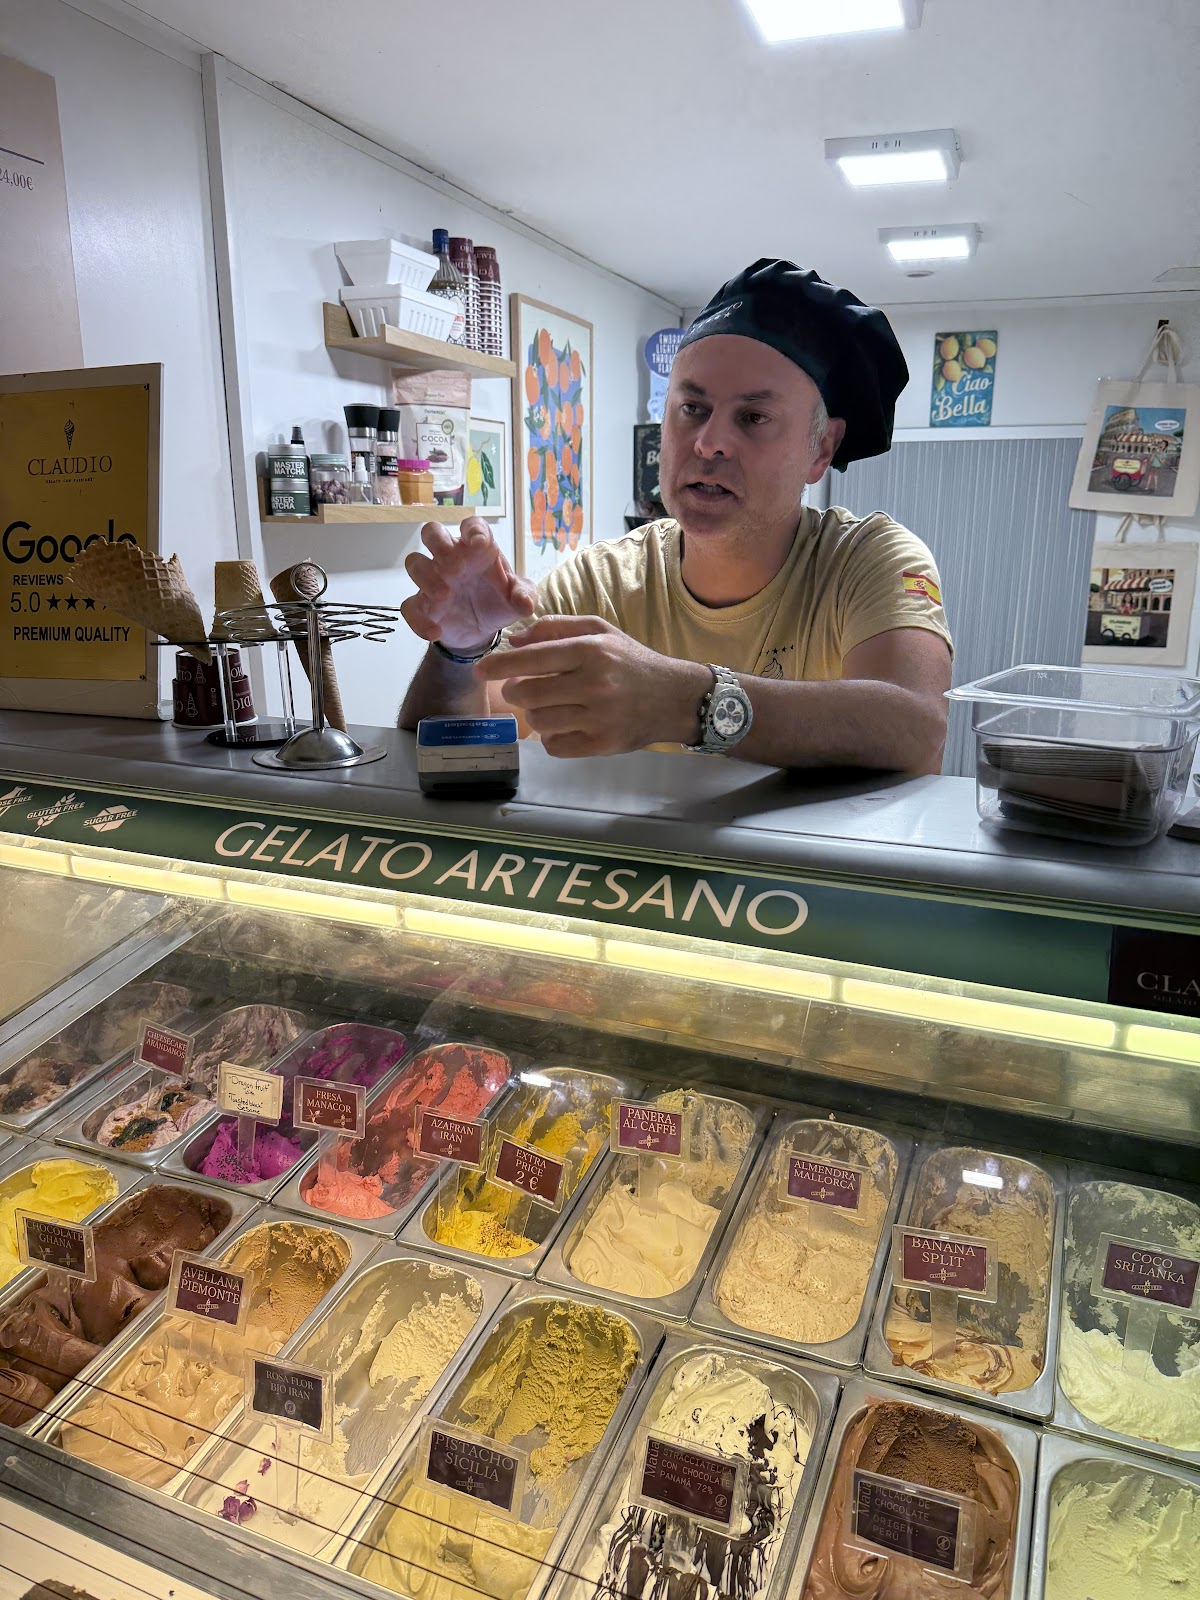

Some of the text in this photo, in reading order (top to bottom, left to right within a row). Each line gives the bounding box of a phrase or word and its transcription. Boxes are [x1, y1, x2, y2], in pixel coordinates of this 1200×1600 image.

[952, 370, 993, 396] Ciao
[931, 391, 988, 421] Bella
[421, 435, 449, 444] COCOA
[27, 455, 113, 476] CLAUDIO
[274, 460, 305, 469] MASTER
[274, 467, 306, 475] MATCHA
[13, 574, 64, 586] REVIEWS
[10, 591, 41, 613] 5.0
[13, 626, 131, 642] PREMIUM QUALITY
[12, 794, 34, 804] FREE
[26, 801, 86, 820] GLUTEN FREE
[83, 809, 139, 827] SUGAR FREE
[214, 821, 811, 936] GELATO ARTESANO
[146, 1038, 186, 1059] ARANDANOS
[147, 1030, 188, 1052] CHEESECAKE
[306, 1098, 352, 1114] MANACOR
[316, 1090, 343, 1103] FRESA
[622, 1118, 638, 1130] AL
[627, 1107, 673, 1125] PANERA
[430, 1118, 475, 1136] AZAFRAN
[440, 1131, 463, 1143] IRAN
[515, 1149, 547, 1169] EXTRA
[515, 1159, 544, 1178] PRICE
[515, 1170, 539, 1191] 2 €
[793, 1160, 857, 1182] ALMENDRA
[793, 1169, 855, 1191] MALLORCA
[26, 1220, 84, 1242] CHOCOLATE
[39, 1233, 73, 1250] GHANA
[911, 1237, 977, 1257] BANANA
[921, 1251, 965, 1268] SPLIT
[1131, 1251, 1173, 1269] COCO
[182, 1266, 241, 1292] AVELLANA
[1114, 1259, 1186, 1285] SRI LANKA
[180, 1278, 240, 1305] PIEMONTE
[266, 1370, 314, 1391] ROSA FLOR
[270, 1382, 311, 1401] BIO IRAN
[435, 1433, 515, 1471] PISTACHO
[444, 1451, 500, 1483] SICILIA
[661, 1459, 731, 1488] CON CHOCOLATE
[660, 1470, 714, 1495] PANAMÁ 72%
[874, 1498, 930, 1522] CHOCOLATE
[918, 1499, 931, 1510] DE
[872, 1525, 899, 1541] PERÚ
[873, 1514, 919, 1537] ORIGEN:
